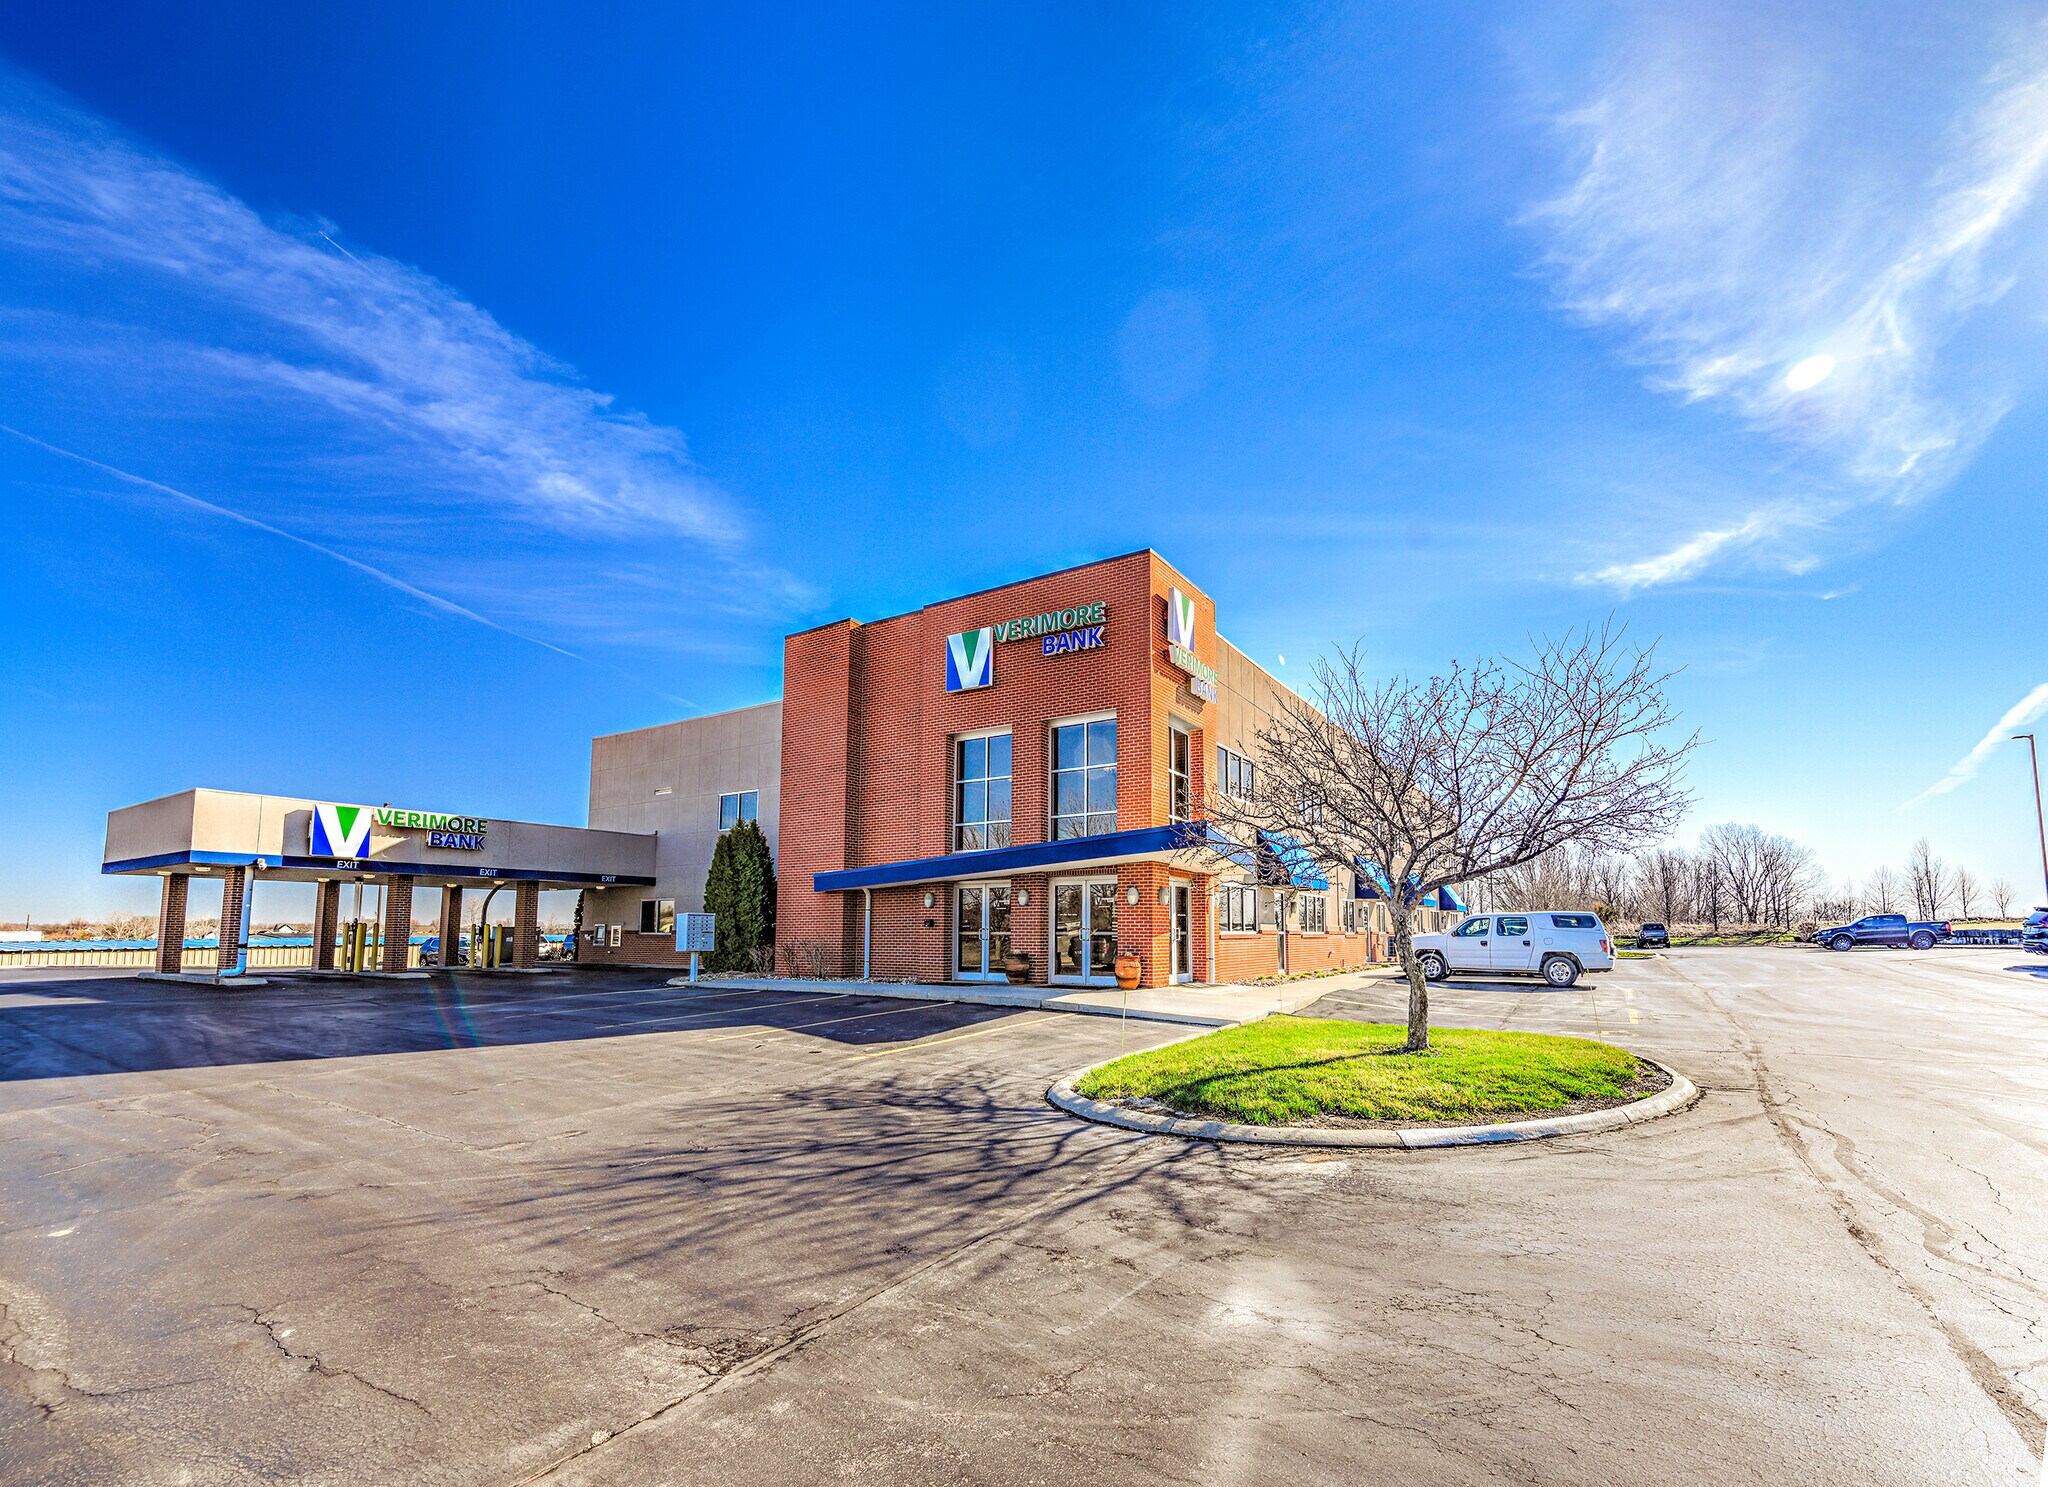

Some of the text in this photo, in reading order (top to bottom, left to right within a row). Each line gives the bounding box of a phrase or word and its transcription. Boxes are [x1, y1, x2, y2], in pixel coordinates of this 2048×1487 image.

[994, 601, 1106, 643] VERIMORE
[1042, 626, 1104, 656] BANK
[1174, 645, 1218, 686] VERIMORE
[1195, 678, 1218, 704] BANK
[376, 808, 488, 834] VERIMORE
[428, 831, 487, 850] BANK
[337, 860, 359, 869] EXIT
[480, 868, 497, 876] EXIT
